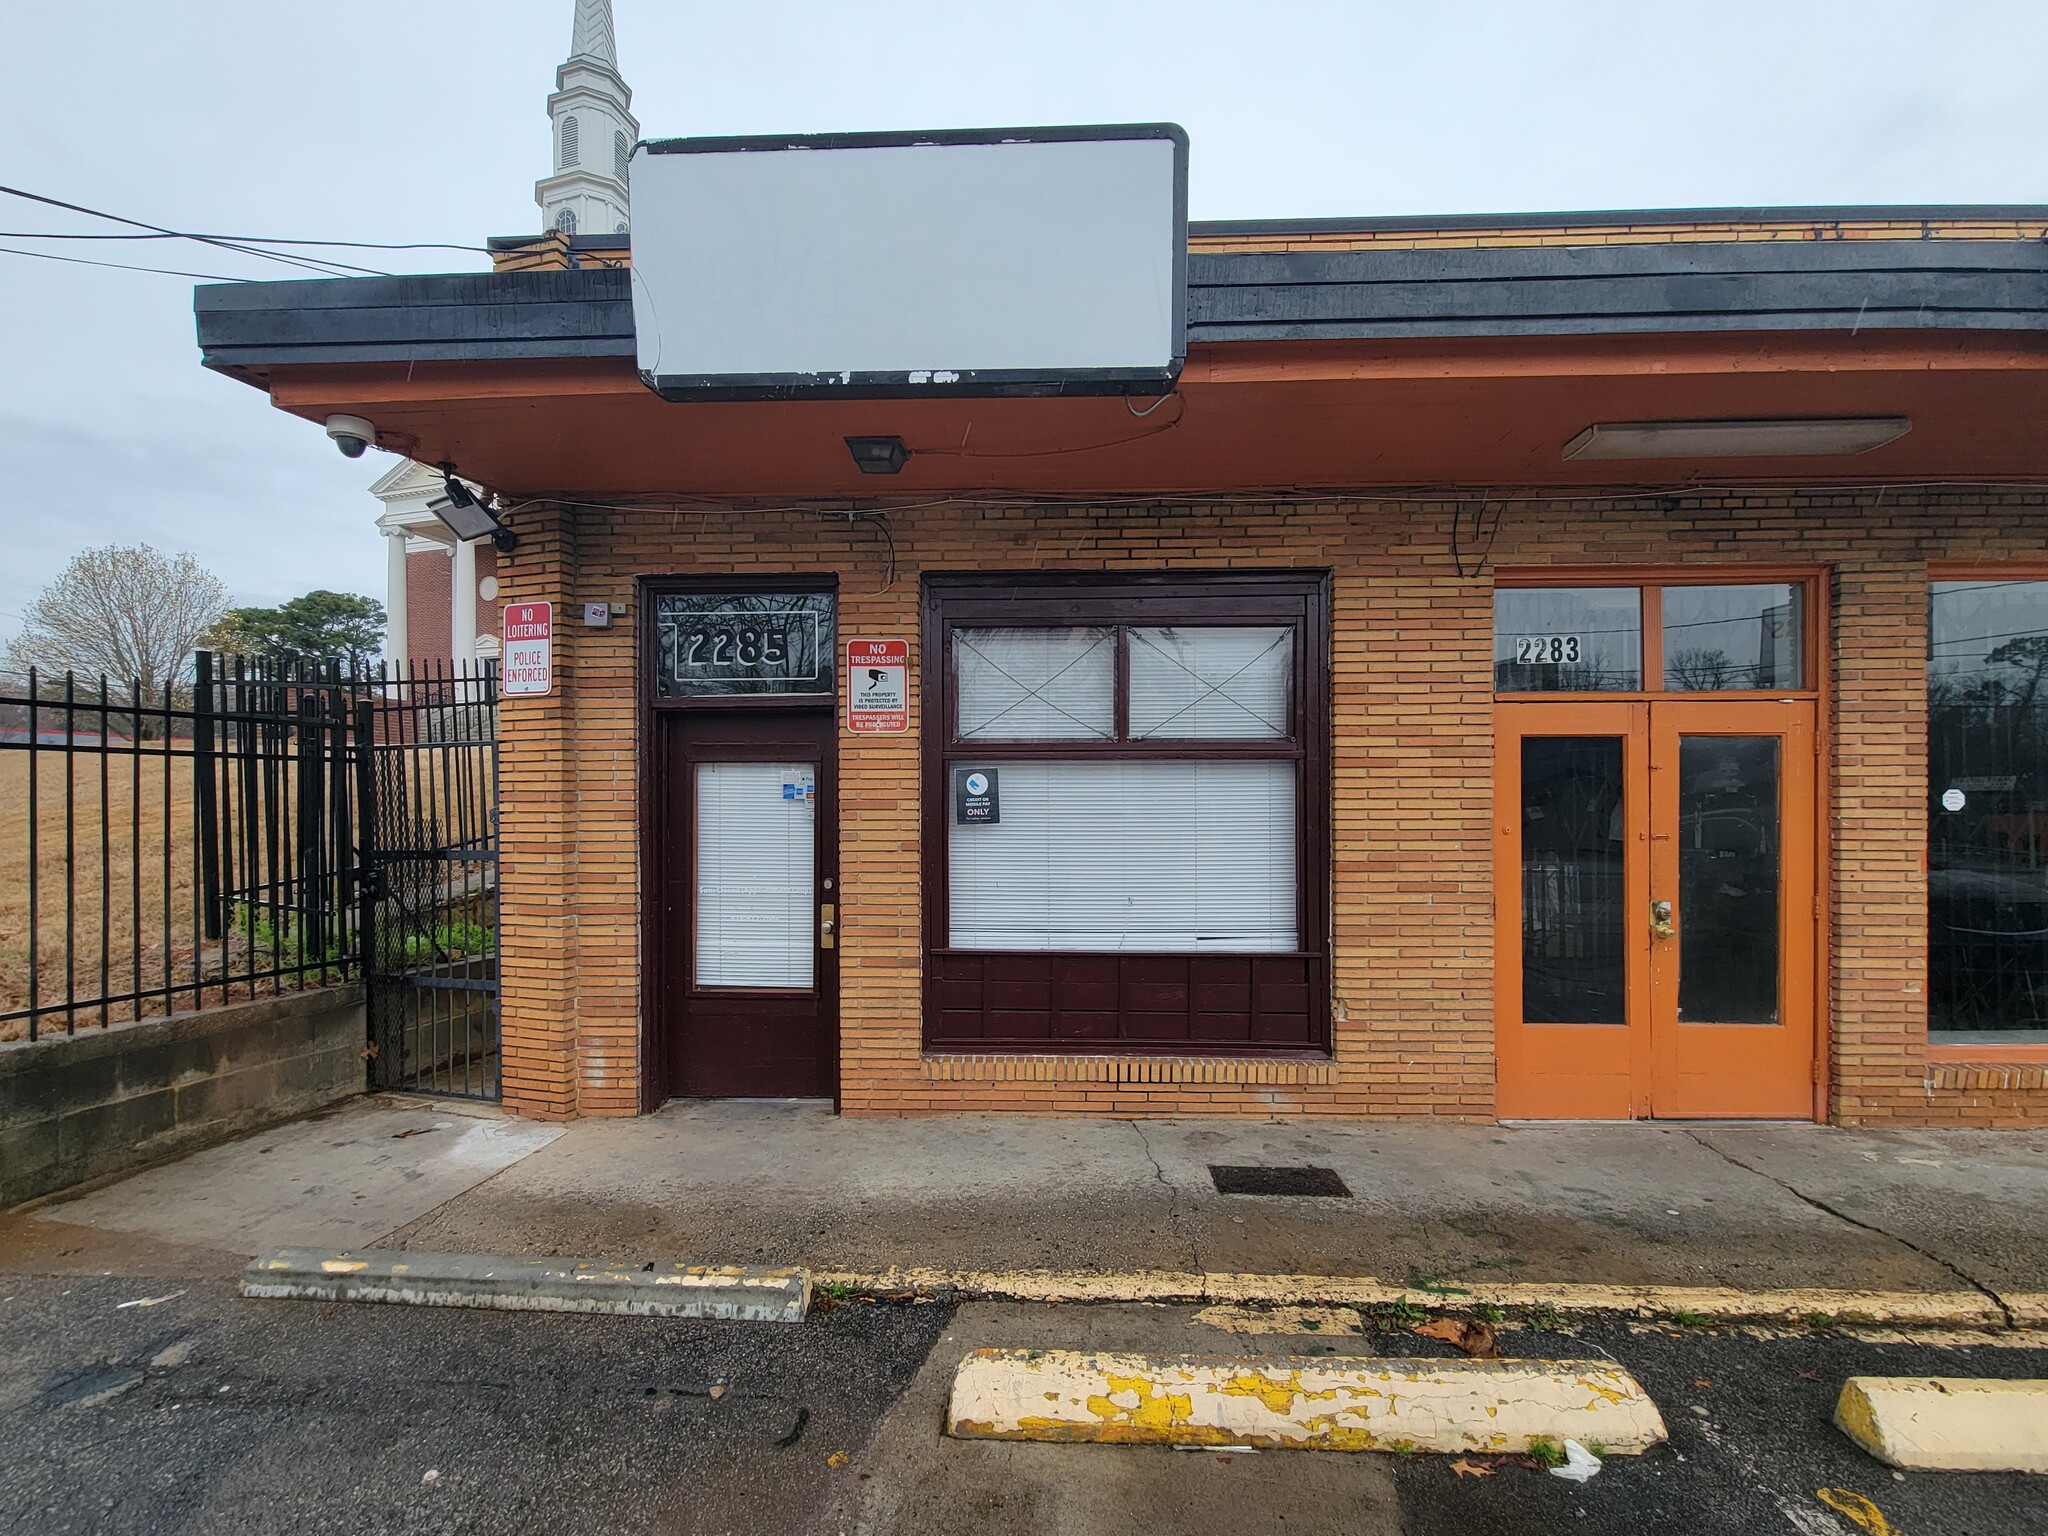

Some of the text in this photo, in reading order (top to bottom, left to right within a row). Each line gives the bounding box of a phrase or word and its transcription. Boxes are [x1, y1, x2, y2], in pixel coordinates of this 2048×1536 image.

[521, 608, 533, 622] NO
[507, 623, 548, 638] LOITERING
[688, 627, 788, 666] 2285
[869, 643, 887, 655] NO
[1518, 636, 1579, 663] 2283
[513, 651, 542, 666] POLICE
[850, 655, 905, 664] TRESPASSING
[507, 667, 548, 683] ENFORCED
[966, 808, 990, 816] ONLY
